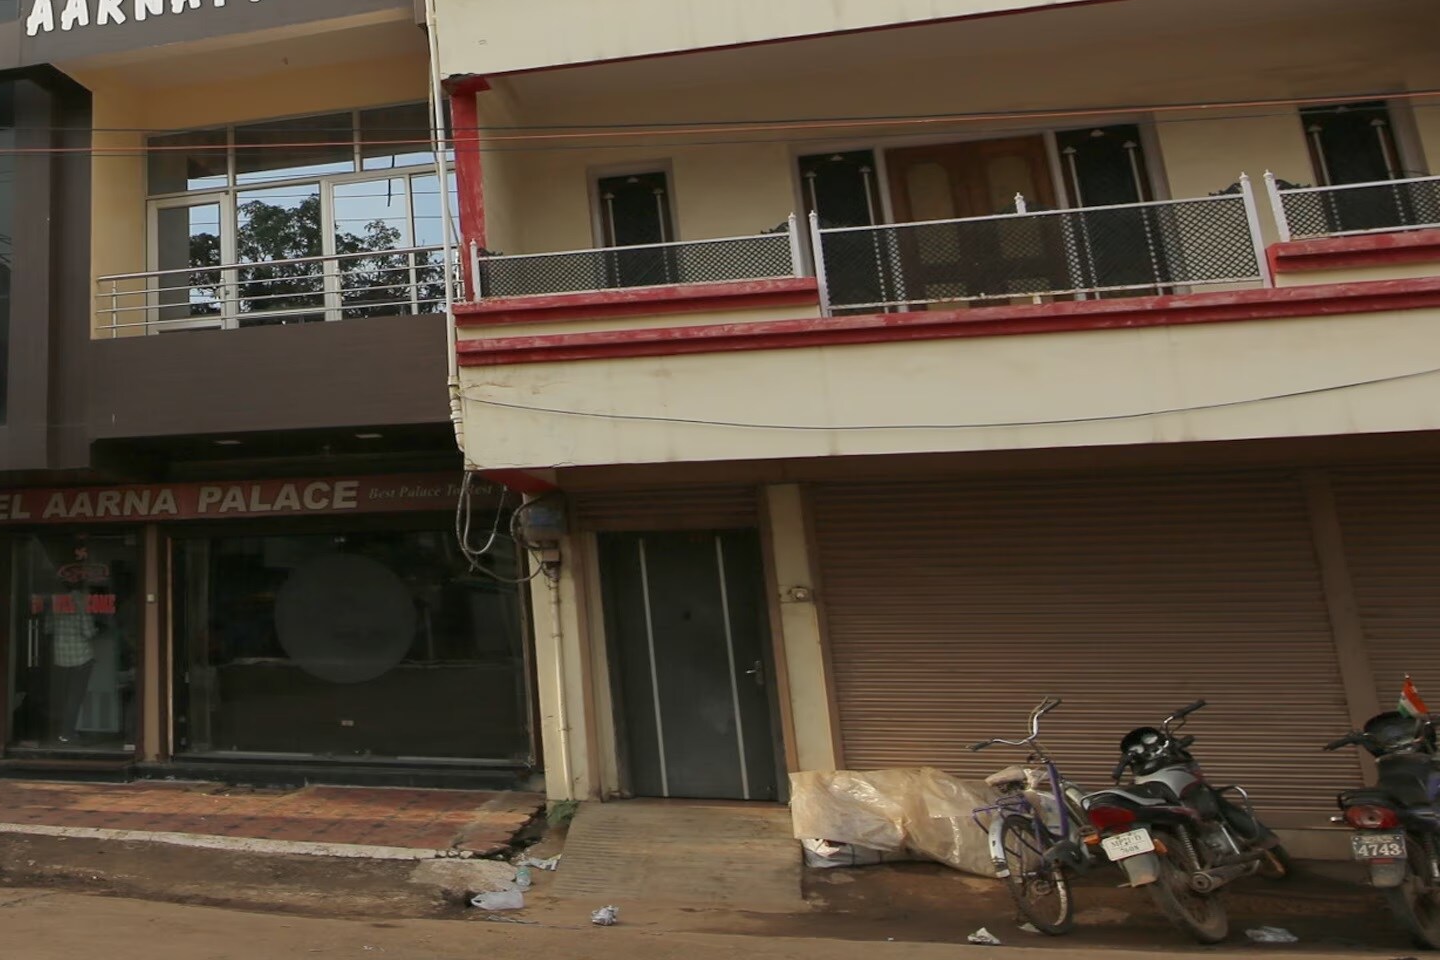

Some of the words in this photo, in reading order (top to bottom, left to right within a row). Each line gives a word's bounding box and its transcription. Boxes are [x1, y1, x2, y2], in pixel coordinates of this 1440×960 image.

[42, 488, 179, 518] AARNA
[197, 480, 359, 514] PALACE
[368, 487, 395, 499] Best
[400, 484, 441, 498] Palace
[1358, 843, 1402, 857] 4743
